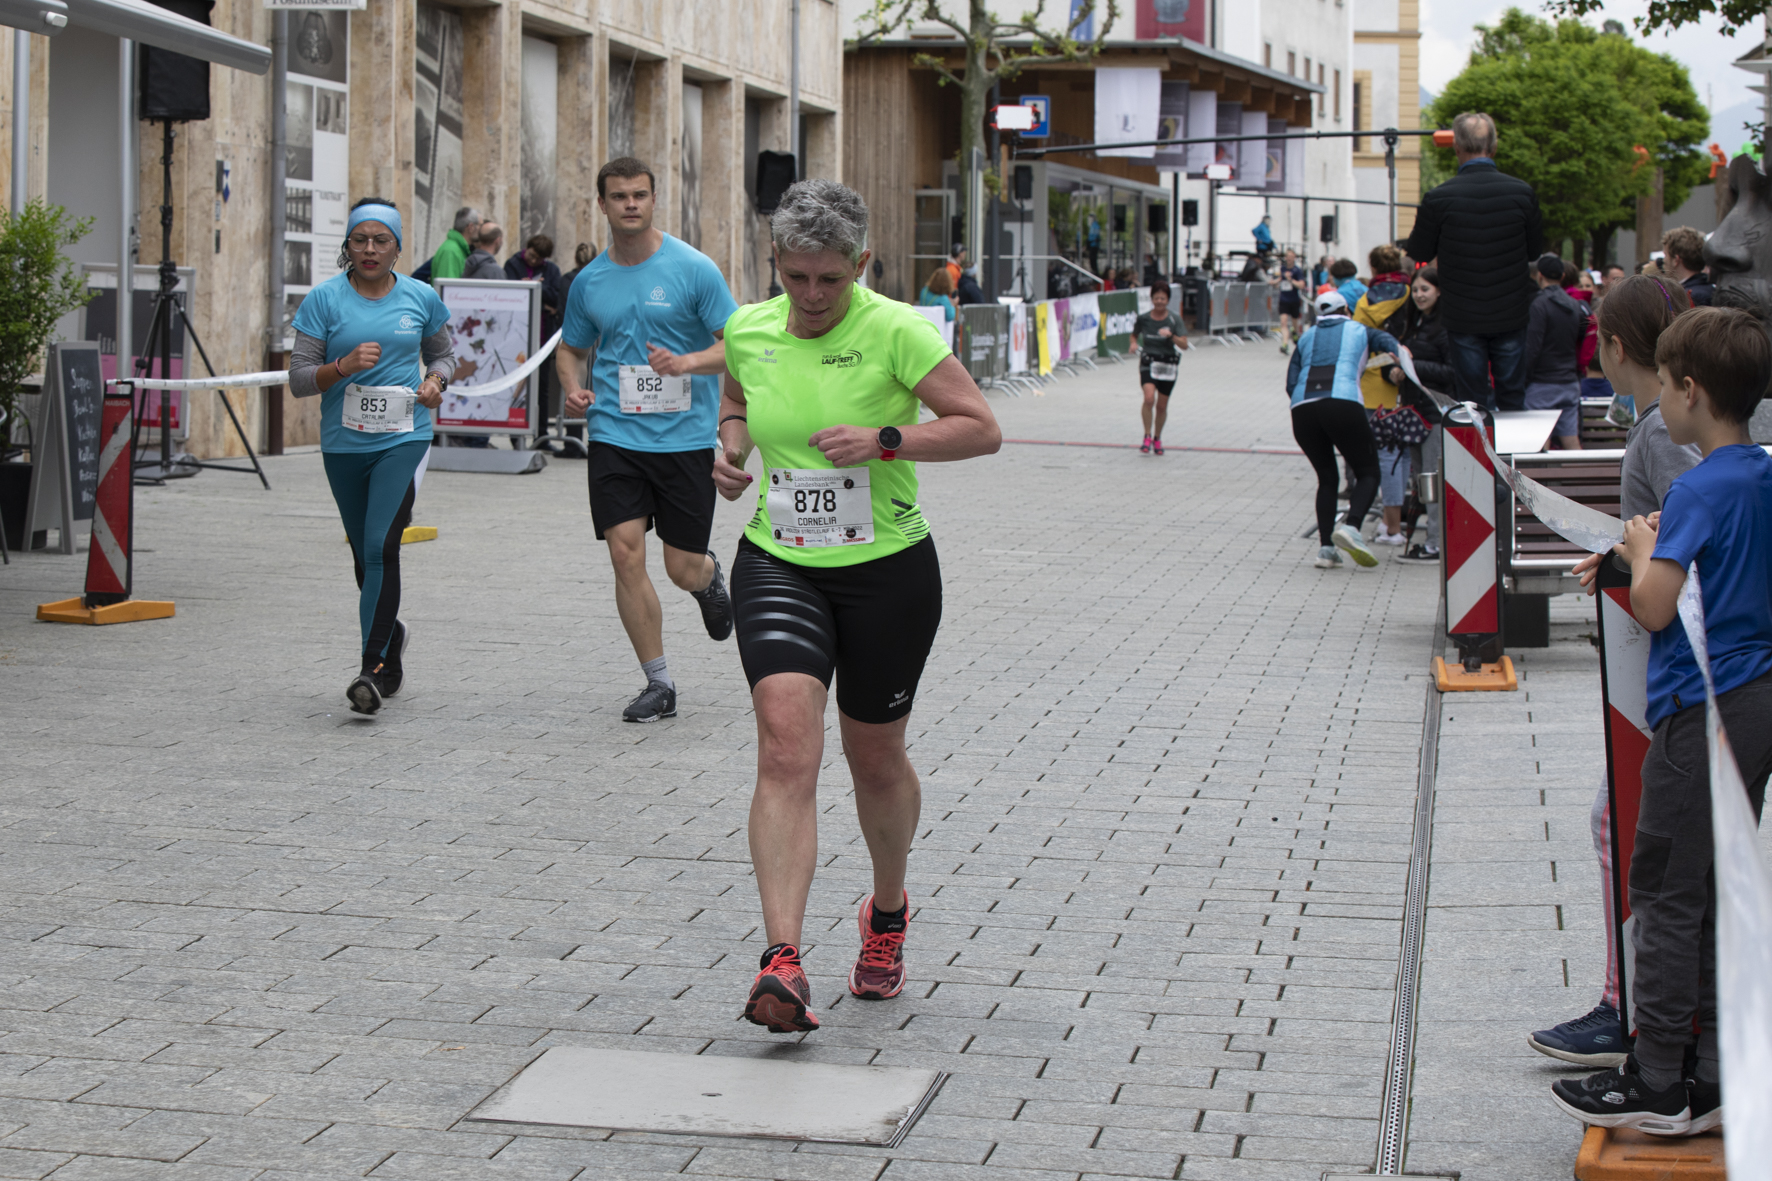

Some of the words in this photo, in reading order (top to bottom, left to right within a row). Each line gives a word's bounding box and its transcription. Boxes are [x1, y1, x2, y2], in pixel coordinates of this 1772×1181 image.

[637, 377, 663, 392] 852
[360, 397, 387, 412] 853
[794, 489, 837, 513] 878
[797, 516, 837, 526] CORNELIA
[888, 695, 909, 708] erima
